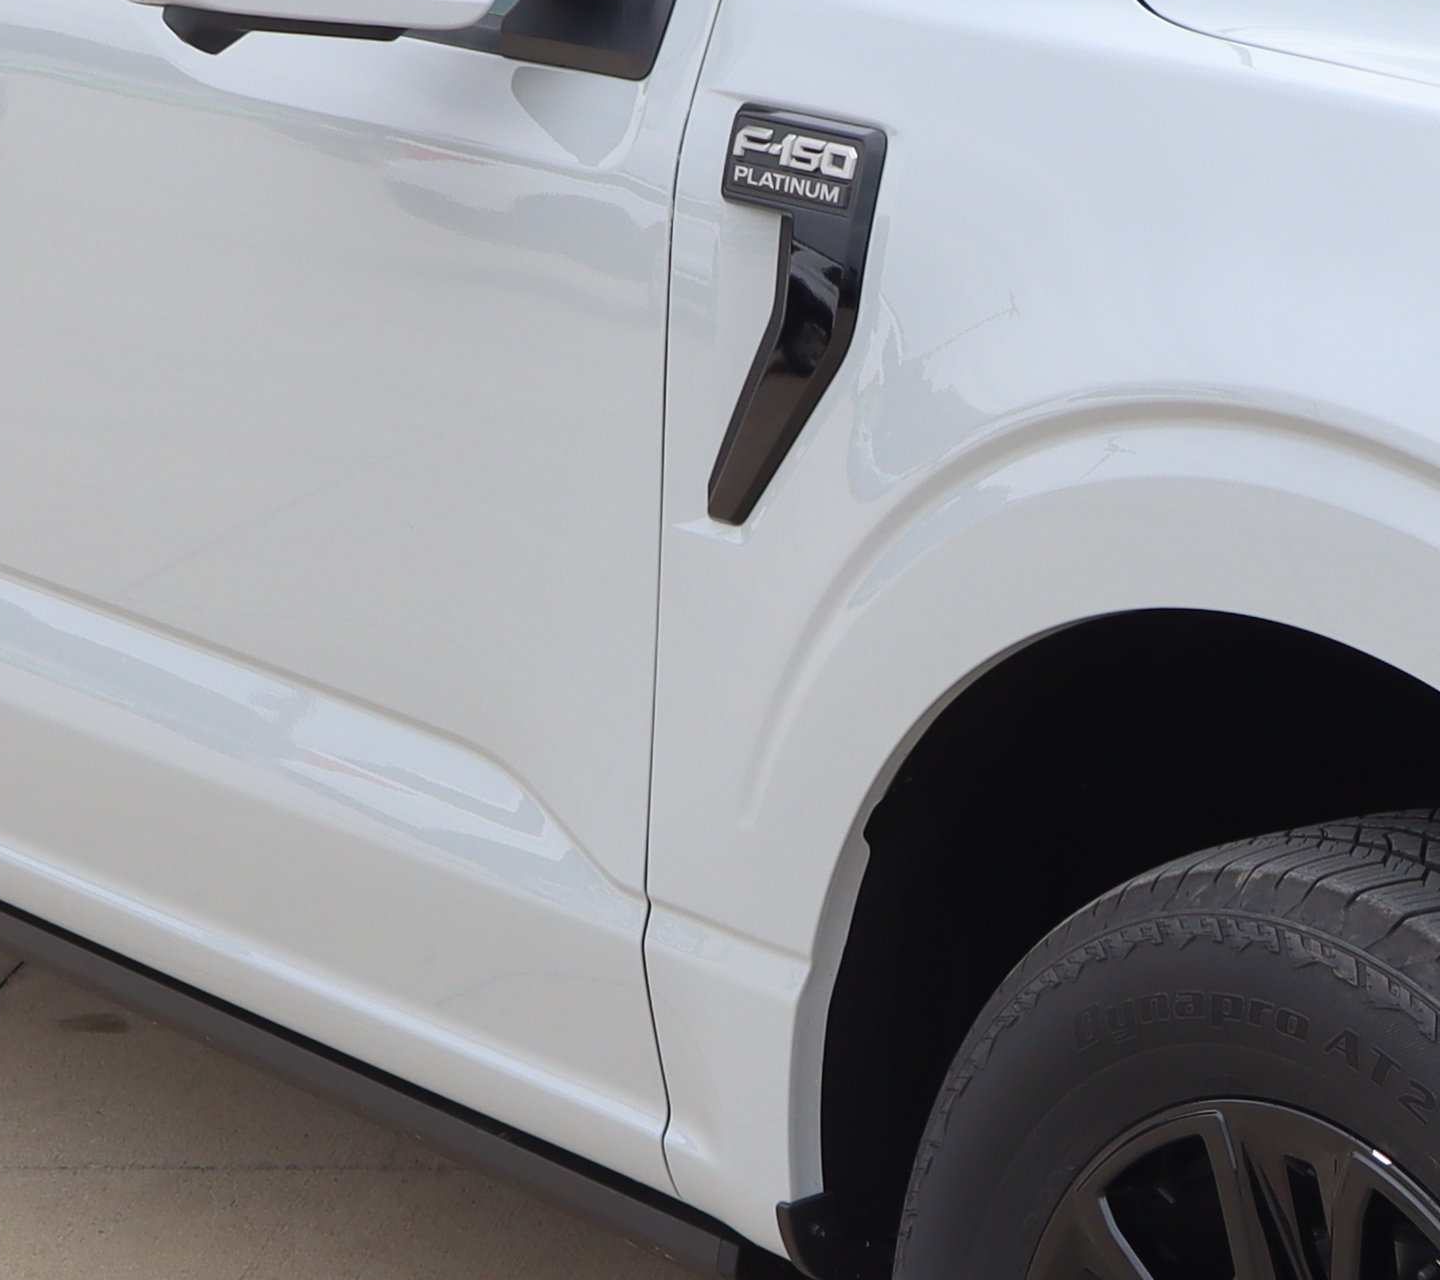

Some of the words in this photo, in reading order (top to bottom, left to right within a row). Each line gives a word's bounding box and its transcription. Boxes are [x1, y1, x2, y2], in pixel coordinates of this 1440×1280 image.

[732, 125, 858, 180] F-150
[733, 165, 841, 204] PLATINUM
[1073, 989, 1312, 1053] Dynapro
